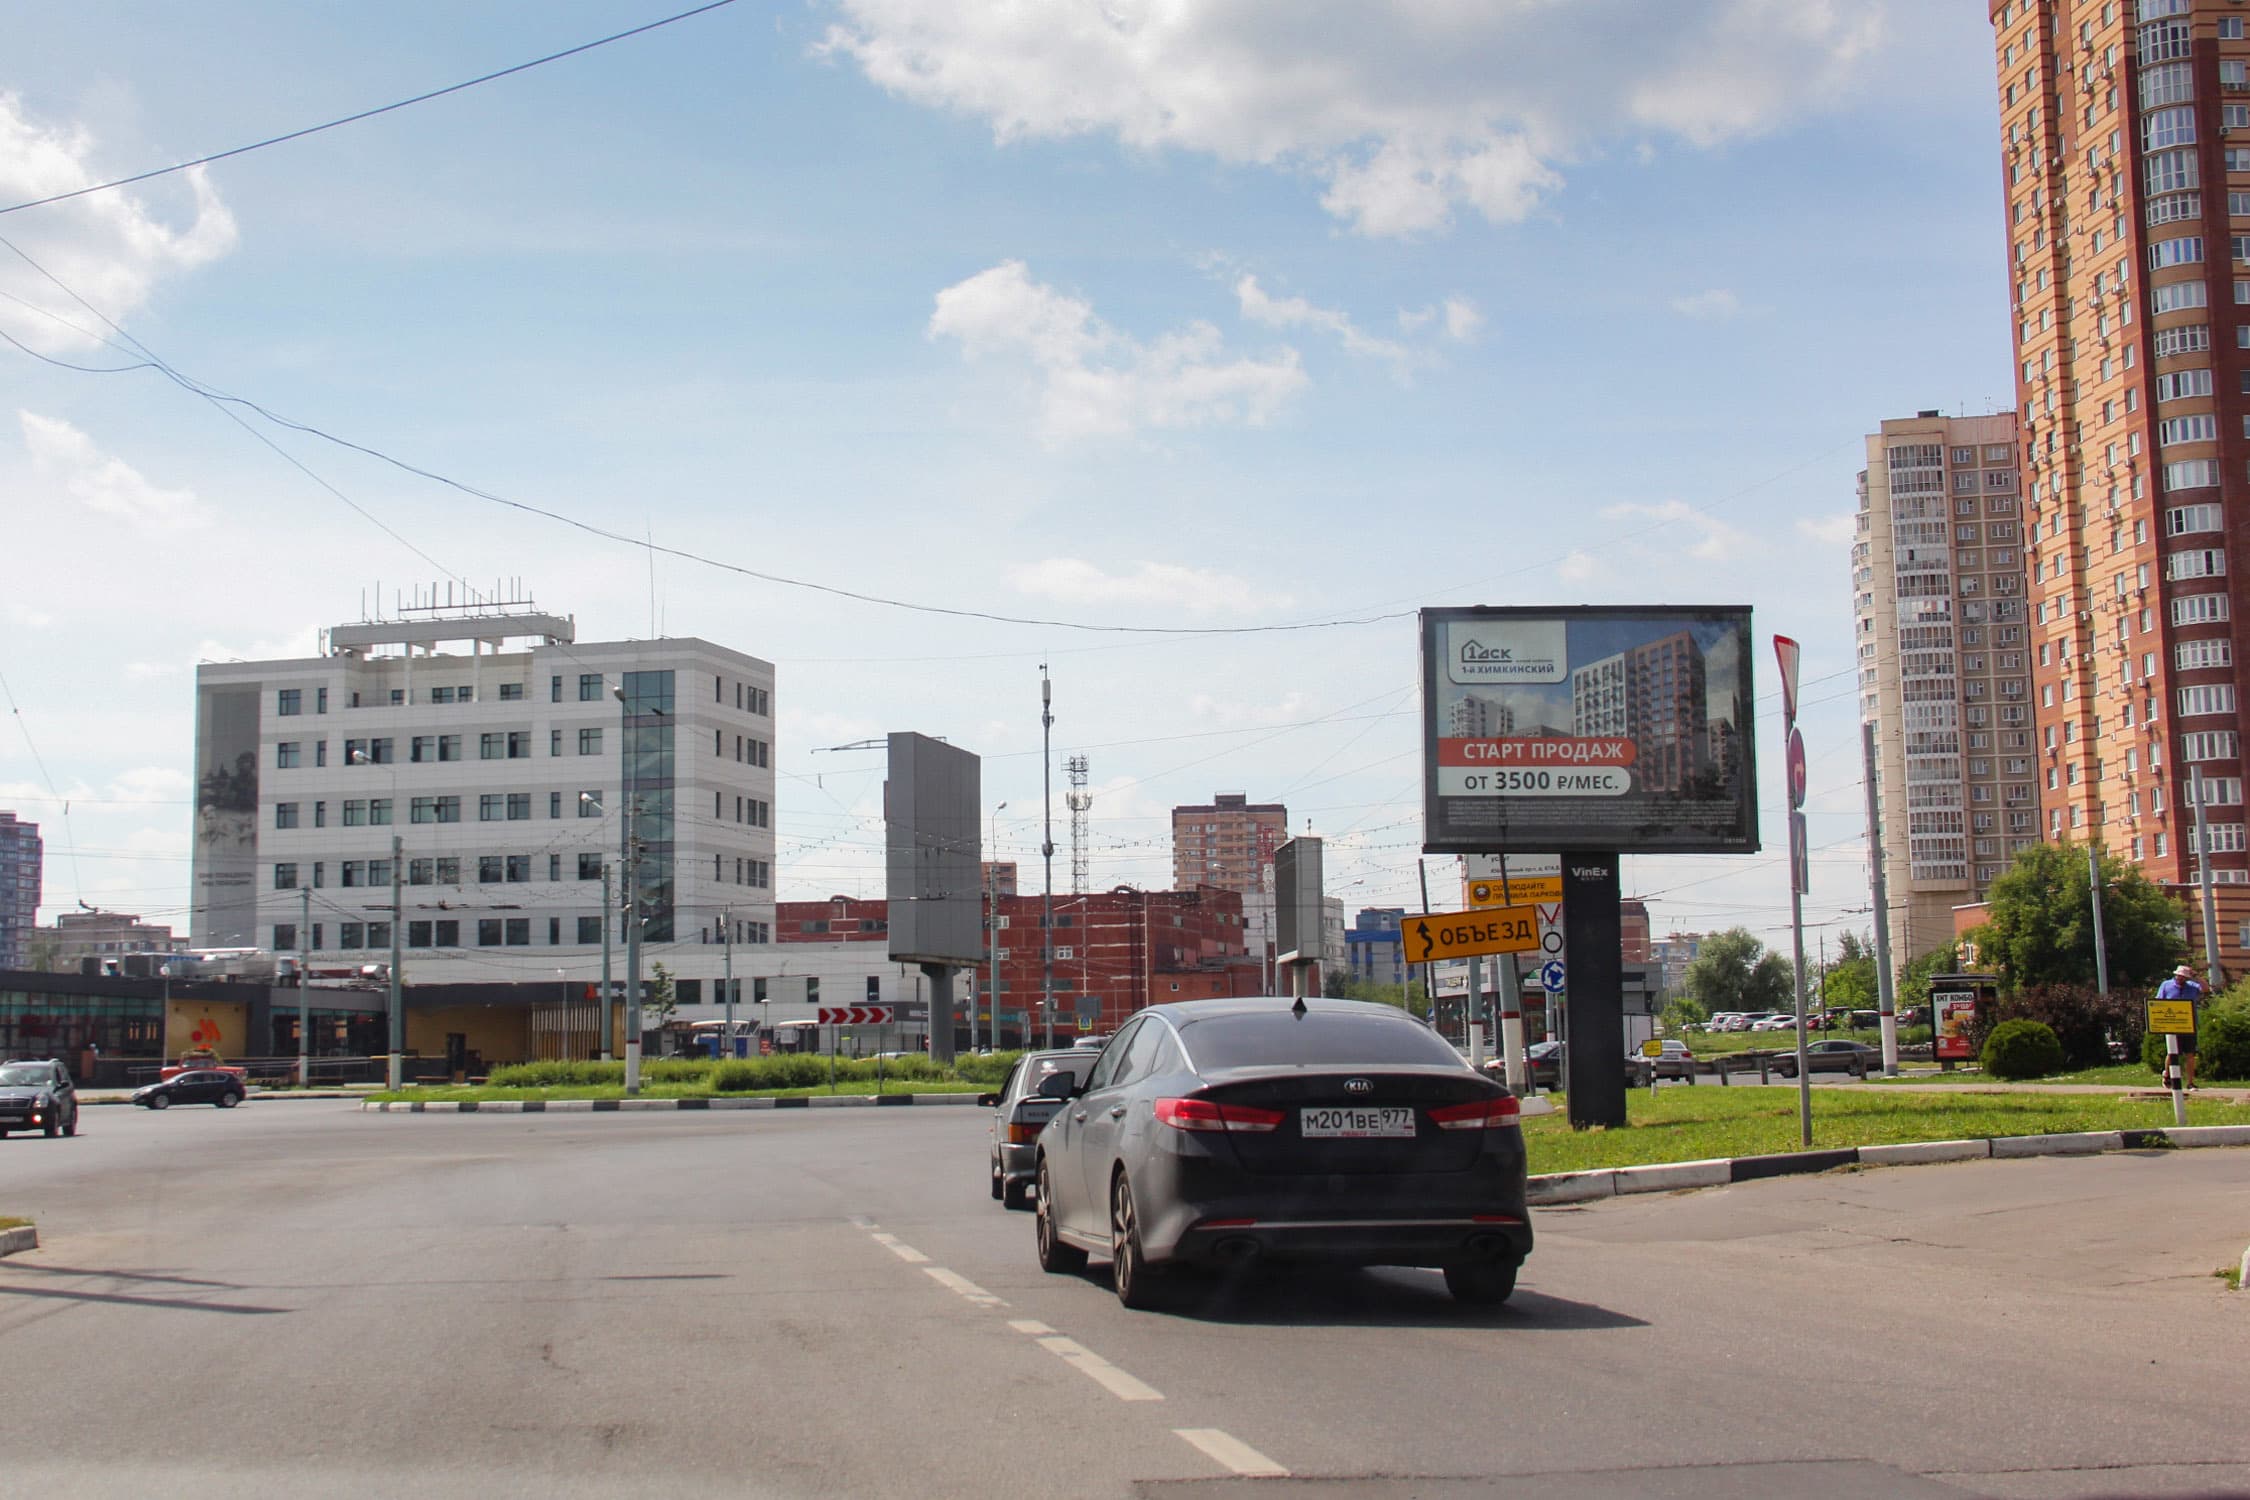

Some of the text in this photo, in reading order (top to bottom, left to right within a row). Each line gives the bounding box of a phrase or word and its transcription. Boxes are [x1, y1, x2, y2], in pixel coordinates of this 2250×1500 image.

[1477, 663, 1555, 674] ХИМКИНСКИЙ
[1463, 743, 1624, 762] СТАРТ ПРОДАЖ
[1464, 776, 1488, 790] ОТ
[1495, 771, 1550, 790] 3500
[1571, 866, 1609, 877] VinEx
[1440, 920, 1532, 946] ОБЪЕЗД
[1950, 994, 1973, 1002] КОМБО
[1349, 1081, 1369, 1091] KIA
[1382, 1109, 1409, 1124] 977
